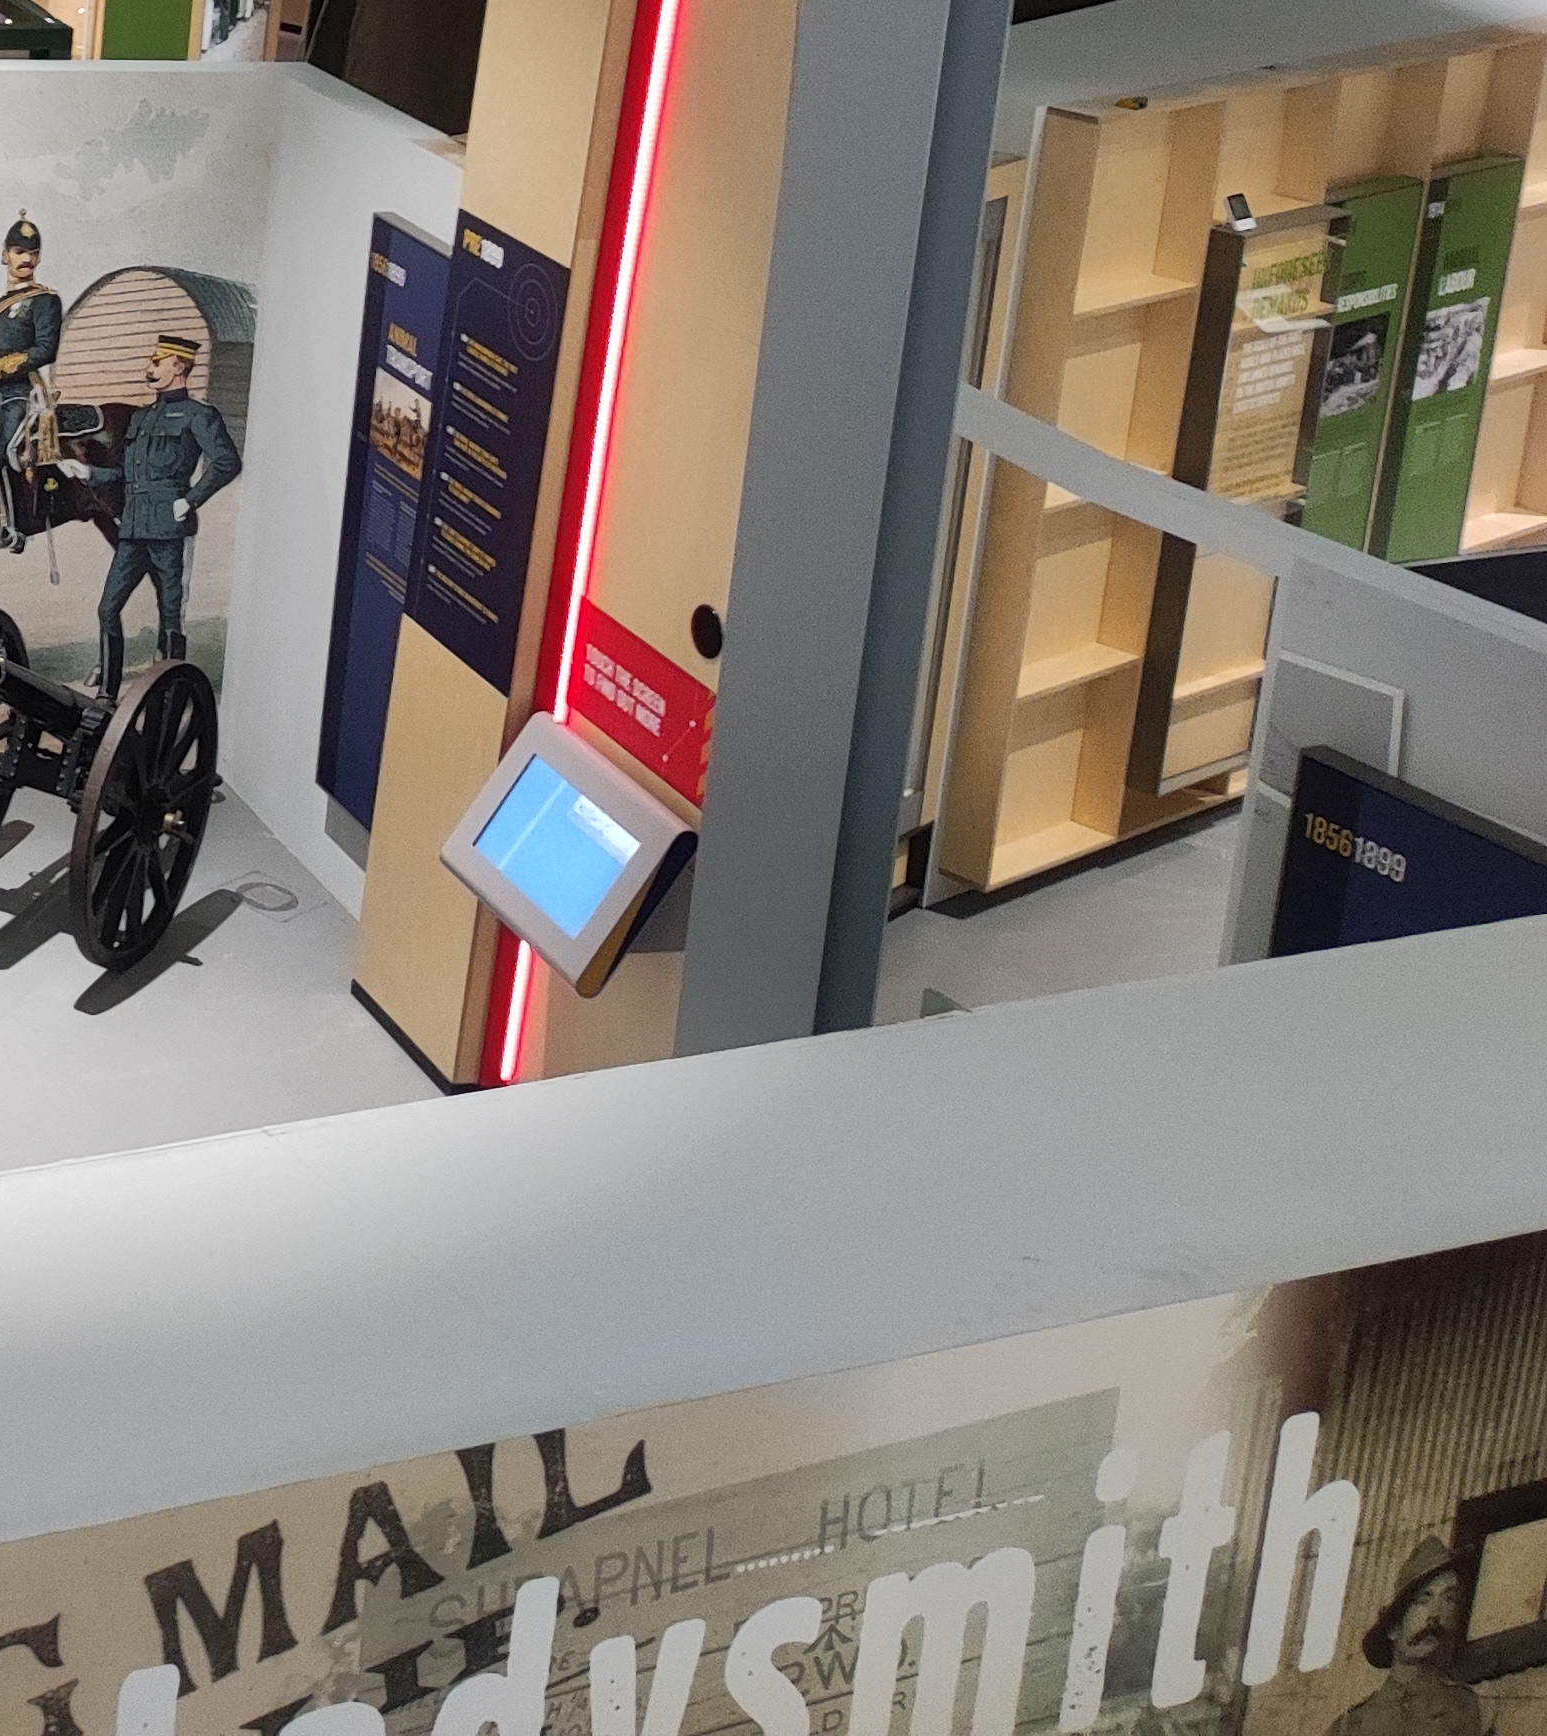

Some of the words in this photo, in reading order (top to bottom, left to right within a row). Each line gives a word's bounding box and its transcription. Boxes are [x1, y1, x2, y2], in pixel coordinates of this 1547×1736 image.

[1305, 812, 1407, 882] 18561899
[818, 1456, 1000, 1553] HOTEL
[144, 1428, 653, 1698] MAIL
